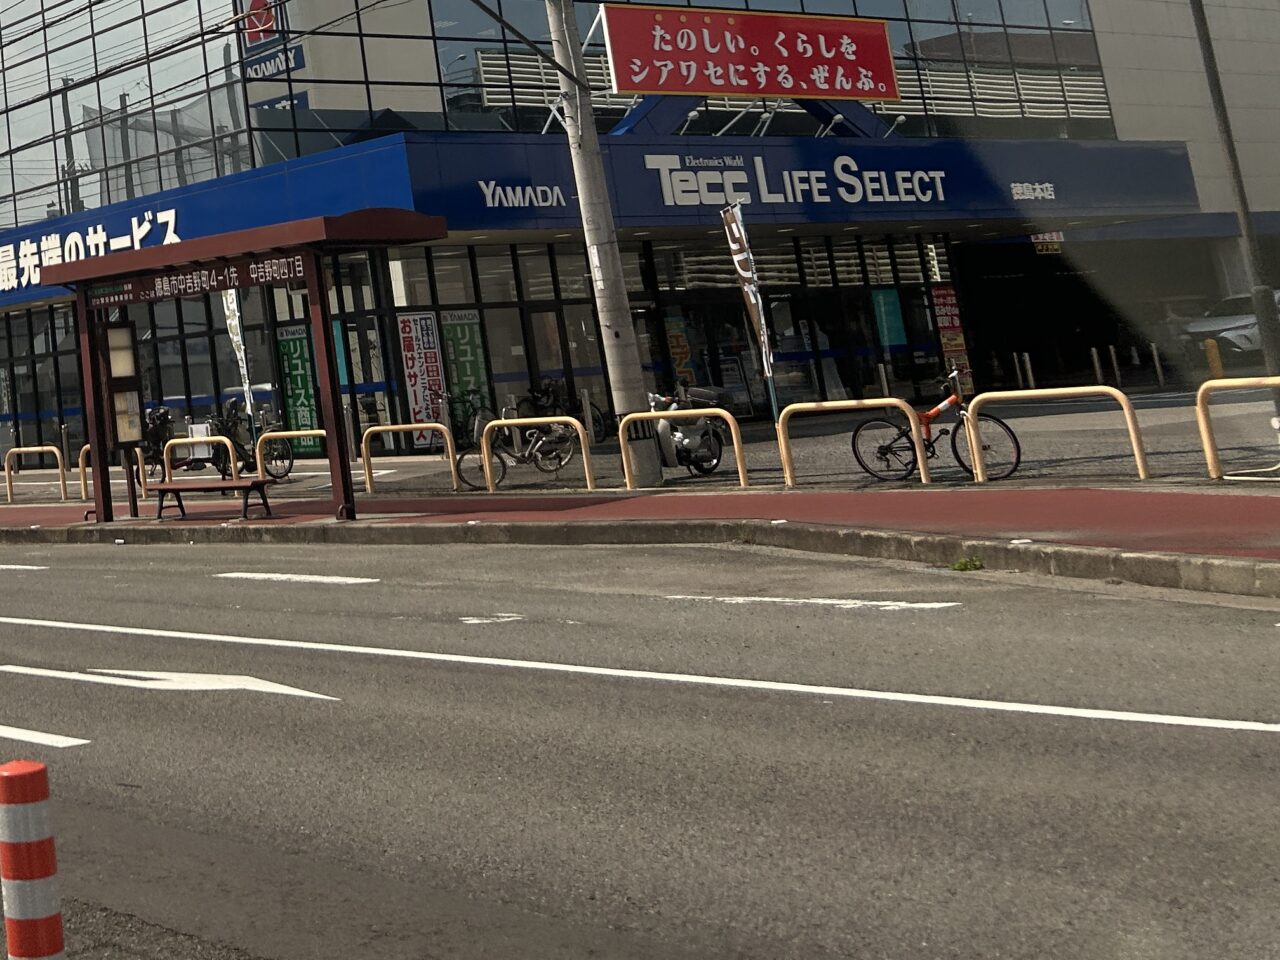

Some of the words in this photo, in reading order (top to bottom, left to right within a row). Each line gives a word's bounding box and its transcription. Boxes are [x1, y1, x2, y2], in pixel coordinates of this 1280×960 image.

[651, 24, 760, 56] たのしい。
[773, 31, 857, 61] くらしを
[628, 58, 887, 92] シアワセにする、ぜんぶ。
[723, 156, 744, 167] World
[478, 180, 567, 208] YAMADA
[644, 154, 752, 206] Tecc
[753, 156, 831, 203] LIFE
[833, 155, 946, 203] SELECT
[1010, 183, 1056, 200] 徳島本店
[249, 256, 304, 283] 中吉野町四丁目
[448, 311, 479, 320] YAMADA
